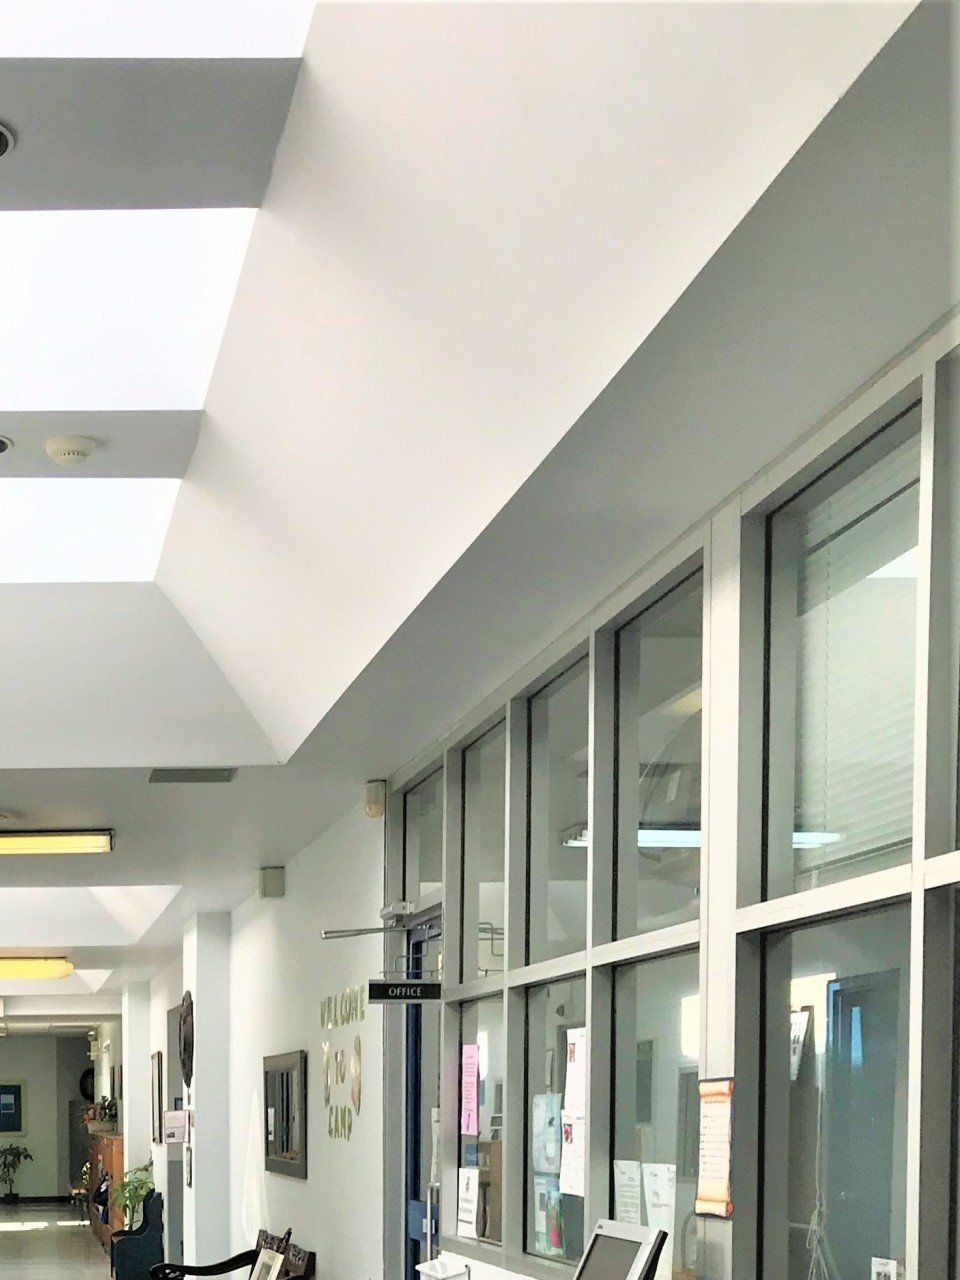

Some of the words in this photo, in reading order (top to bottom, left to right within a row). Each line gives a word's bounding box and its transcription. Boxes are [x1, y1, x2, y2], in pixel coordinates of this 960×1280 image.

[321, 984, 365, 1028] WELCOME
[388, 987, 422, 996] OFFICE
[335, 1049, 346, 1084] TO
[328, 1105, 352, 1141] CAMP
